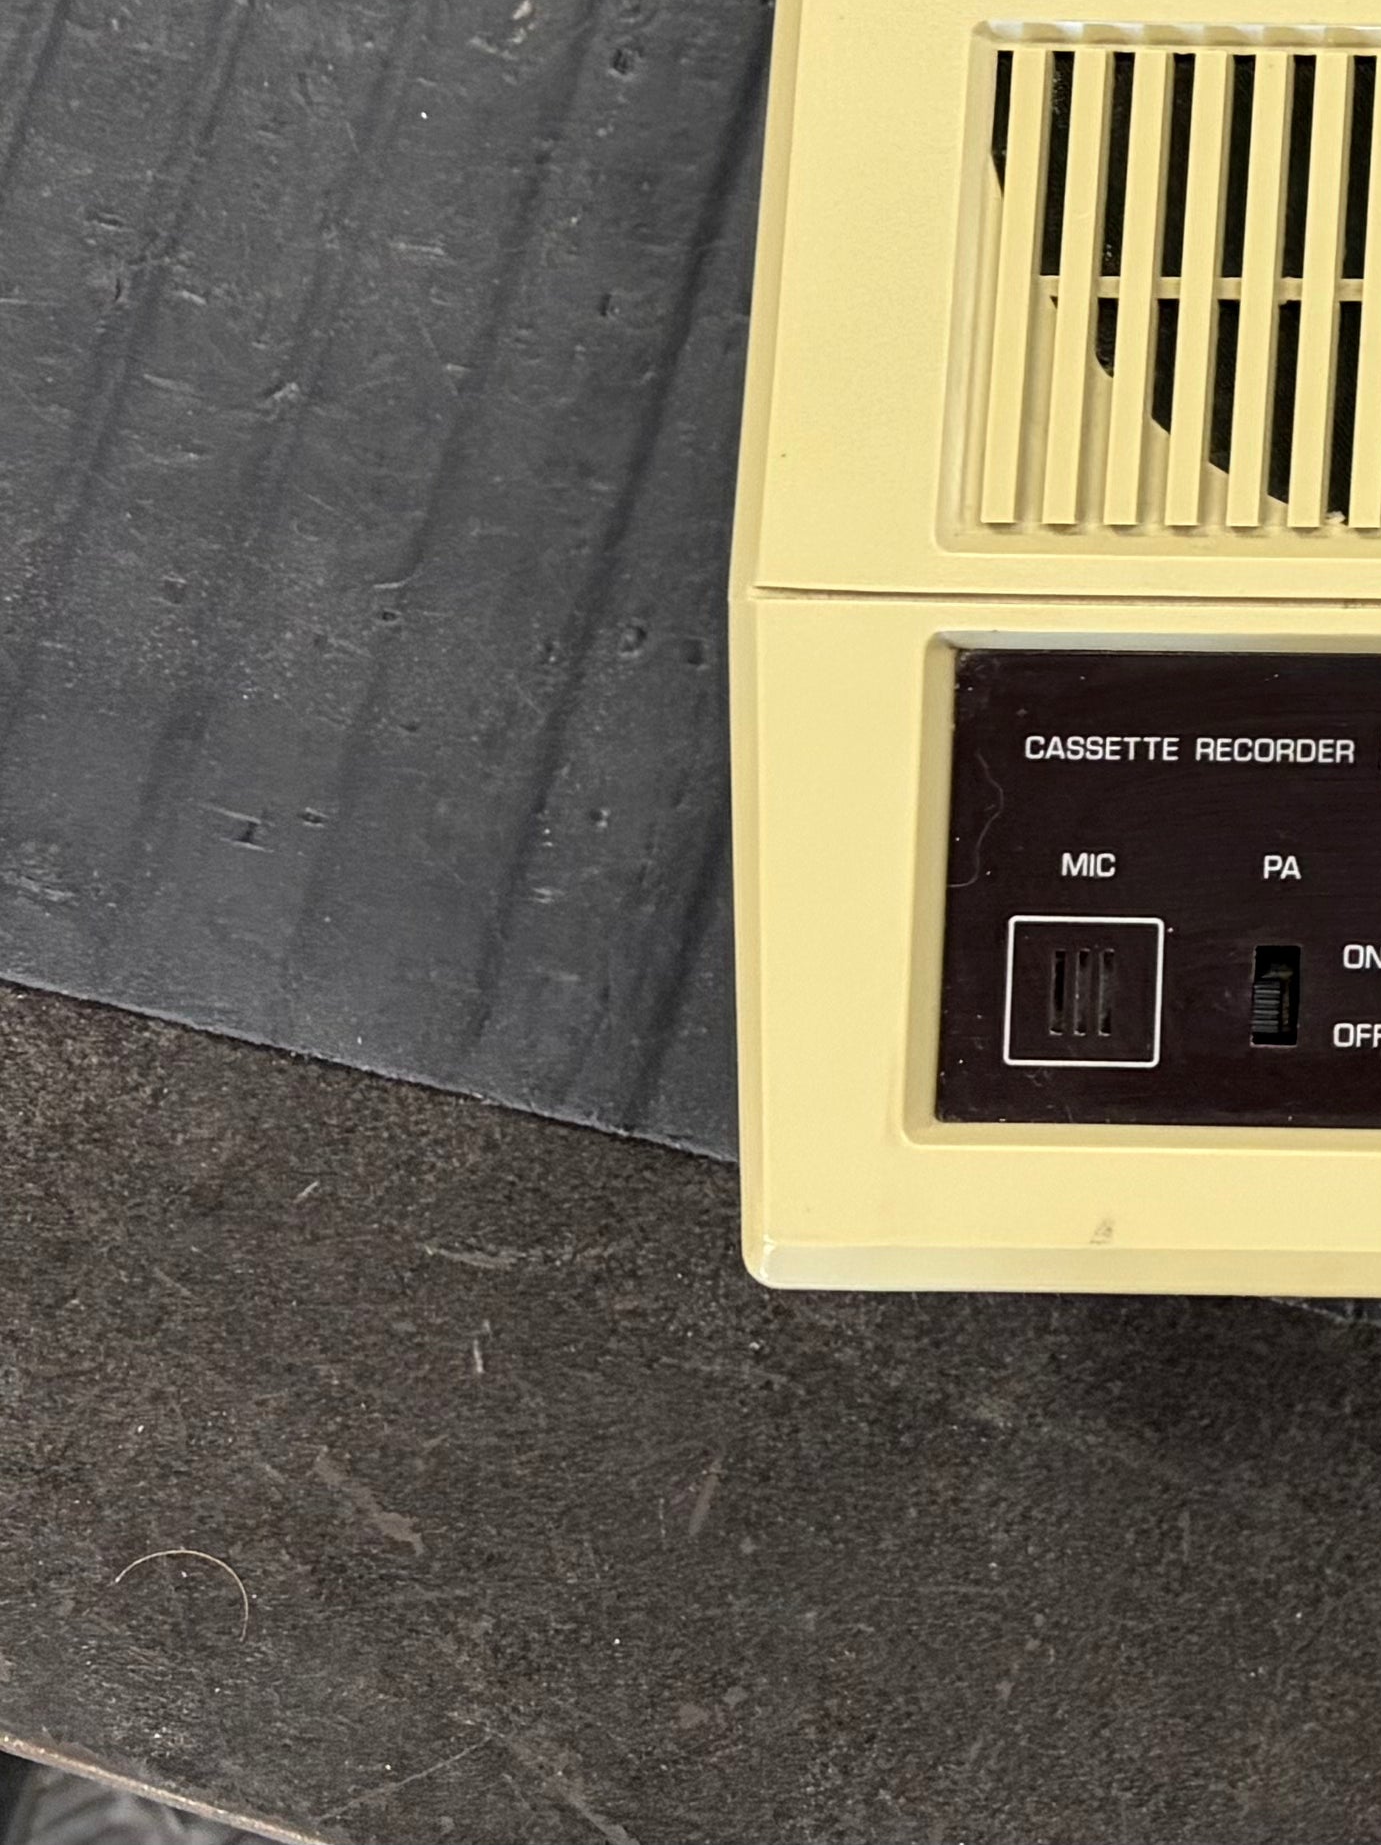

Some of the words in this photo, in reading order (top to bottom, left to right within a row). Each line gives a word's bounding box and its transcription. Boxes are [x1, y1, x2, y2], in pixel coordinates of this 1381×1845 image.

[1025, 735, 1180, 761] CASSETTE
[1195, 737, 1355, 764] RECORDER
[1061, 852, 1116, 878] MIC
[1263, 854, 1301, 880] PA
